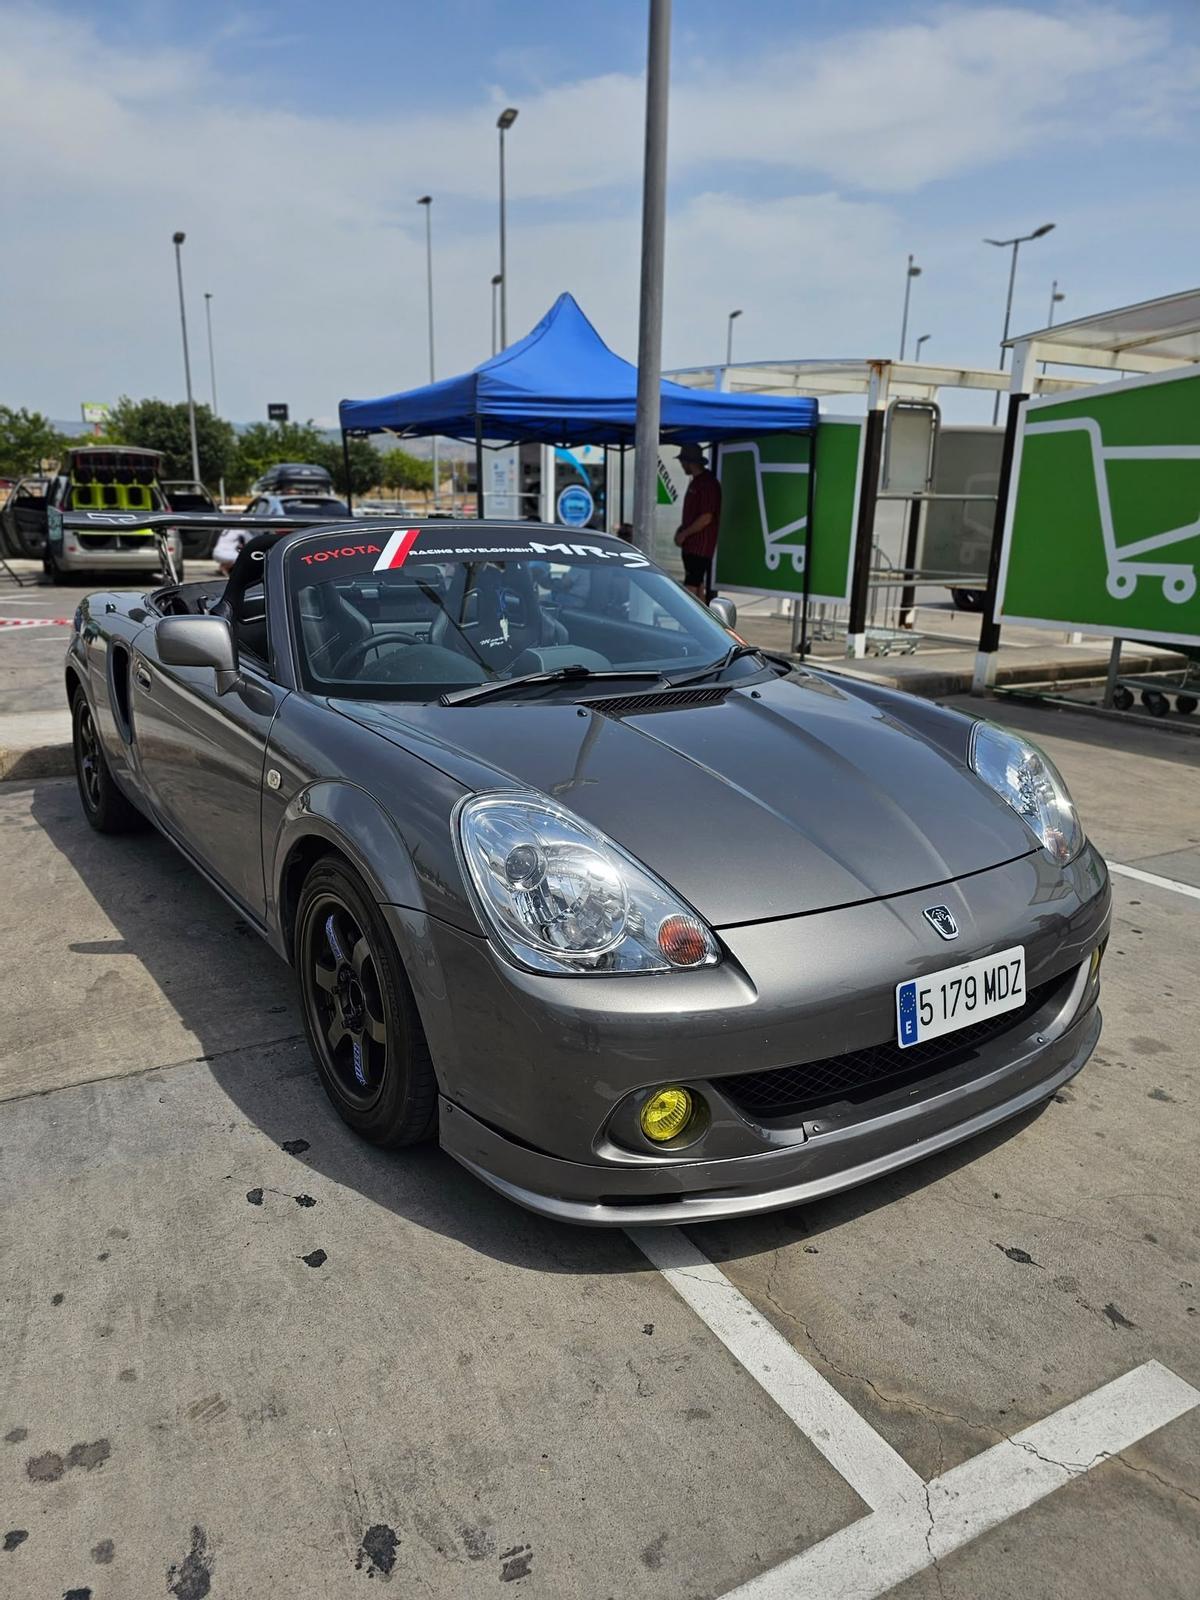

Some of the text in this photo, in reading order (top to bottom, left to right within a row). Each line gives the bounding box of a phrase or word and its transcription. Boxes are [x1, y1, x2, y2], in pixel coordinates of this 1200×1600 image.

[301, 545, 381, 565] TOYOTA
[408, 547, 534, 556] RACING DEVELOPMENT
[919, 959, 1022, 1026] 5179 MDZ
[905, 1020, 913, 1035] E
